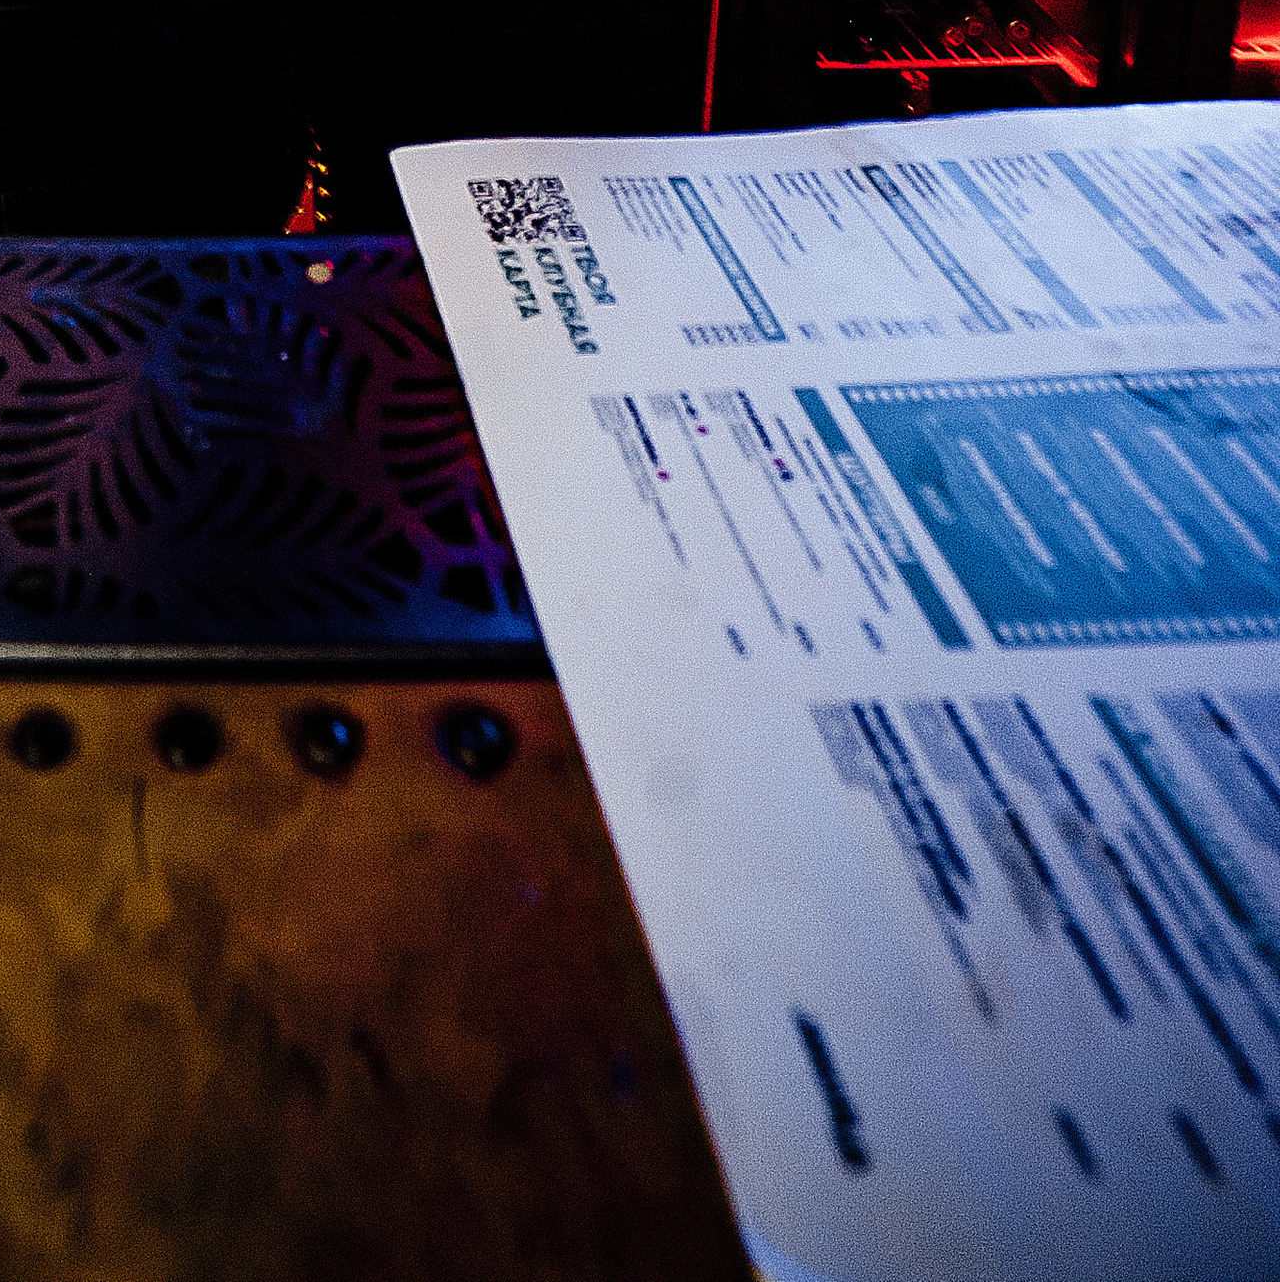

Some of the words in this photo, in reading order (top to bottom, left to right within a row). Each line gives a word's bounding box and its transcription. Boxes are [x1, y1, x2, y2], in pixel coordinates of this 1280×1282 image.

[496, 249, 541, 320] КАРТА
[534, 247, 600, 355] КЛУБНАЯ
[571, 244, 617, 305] ТВОЯ
